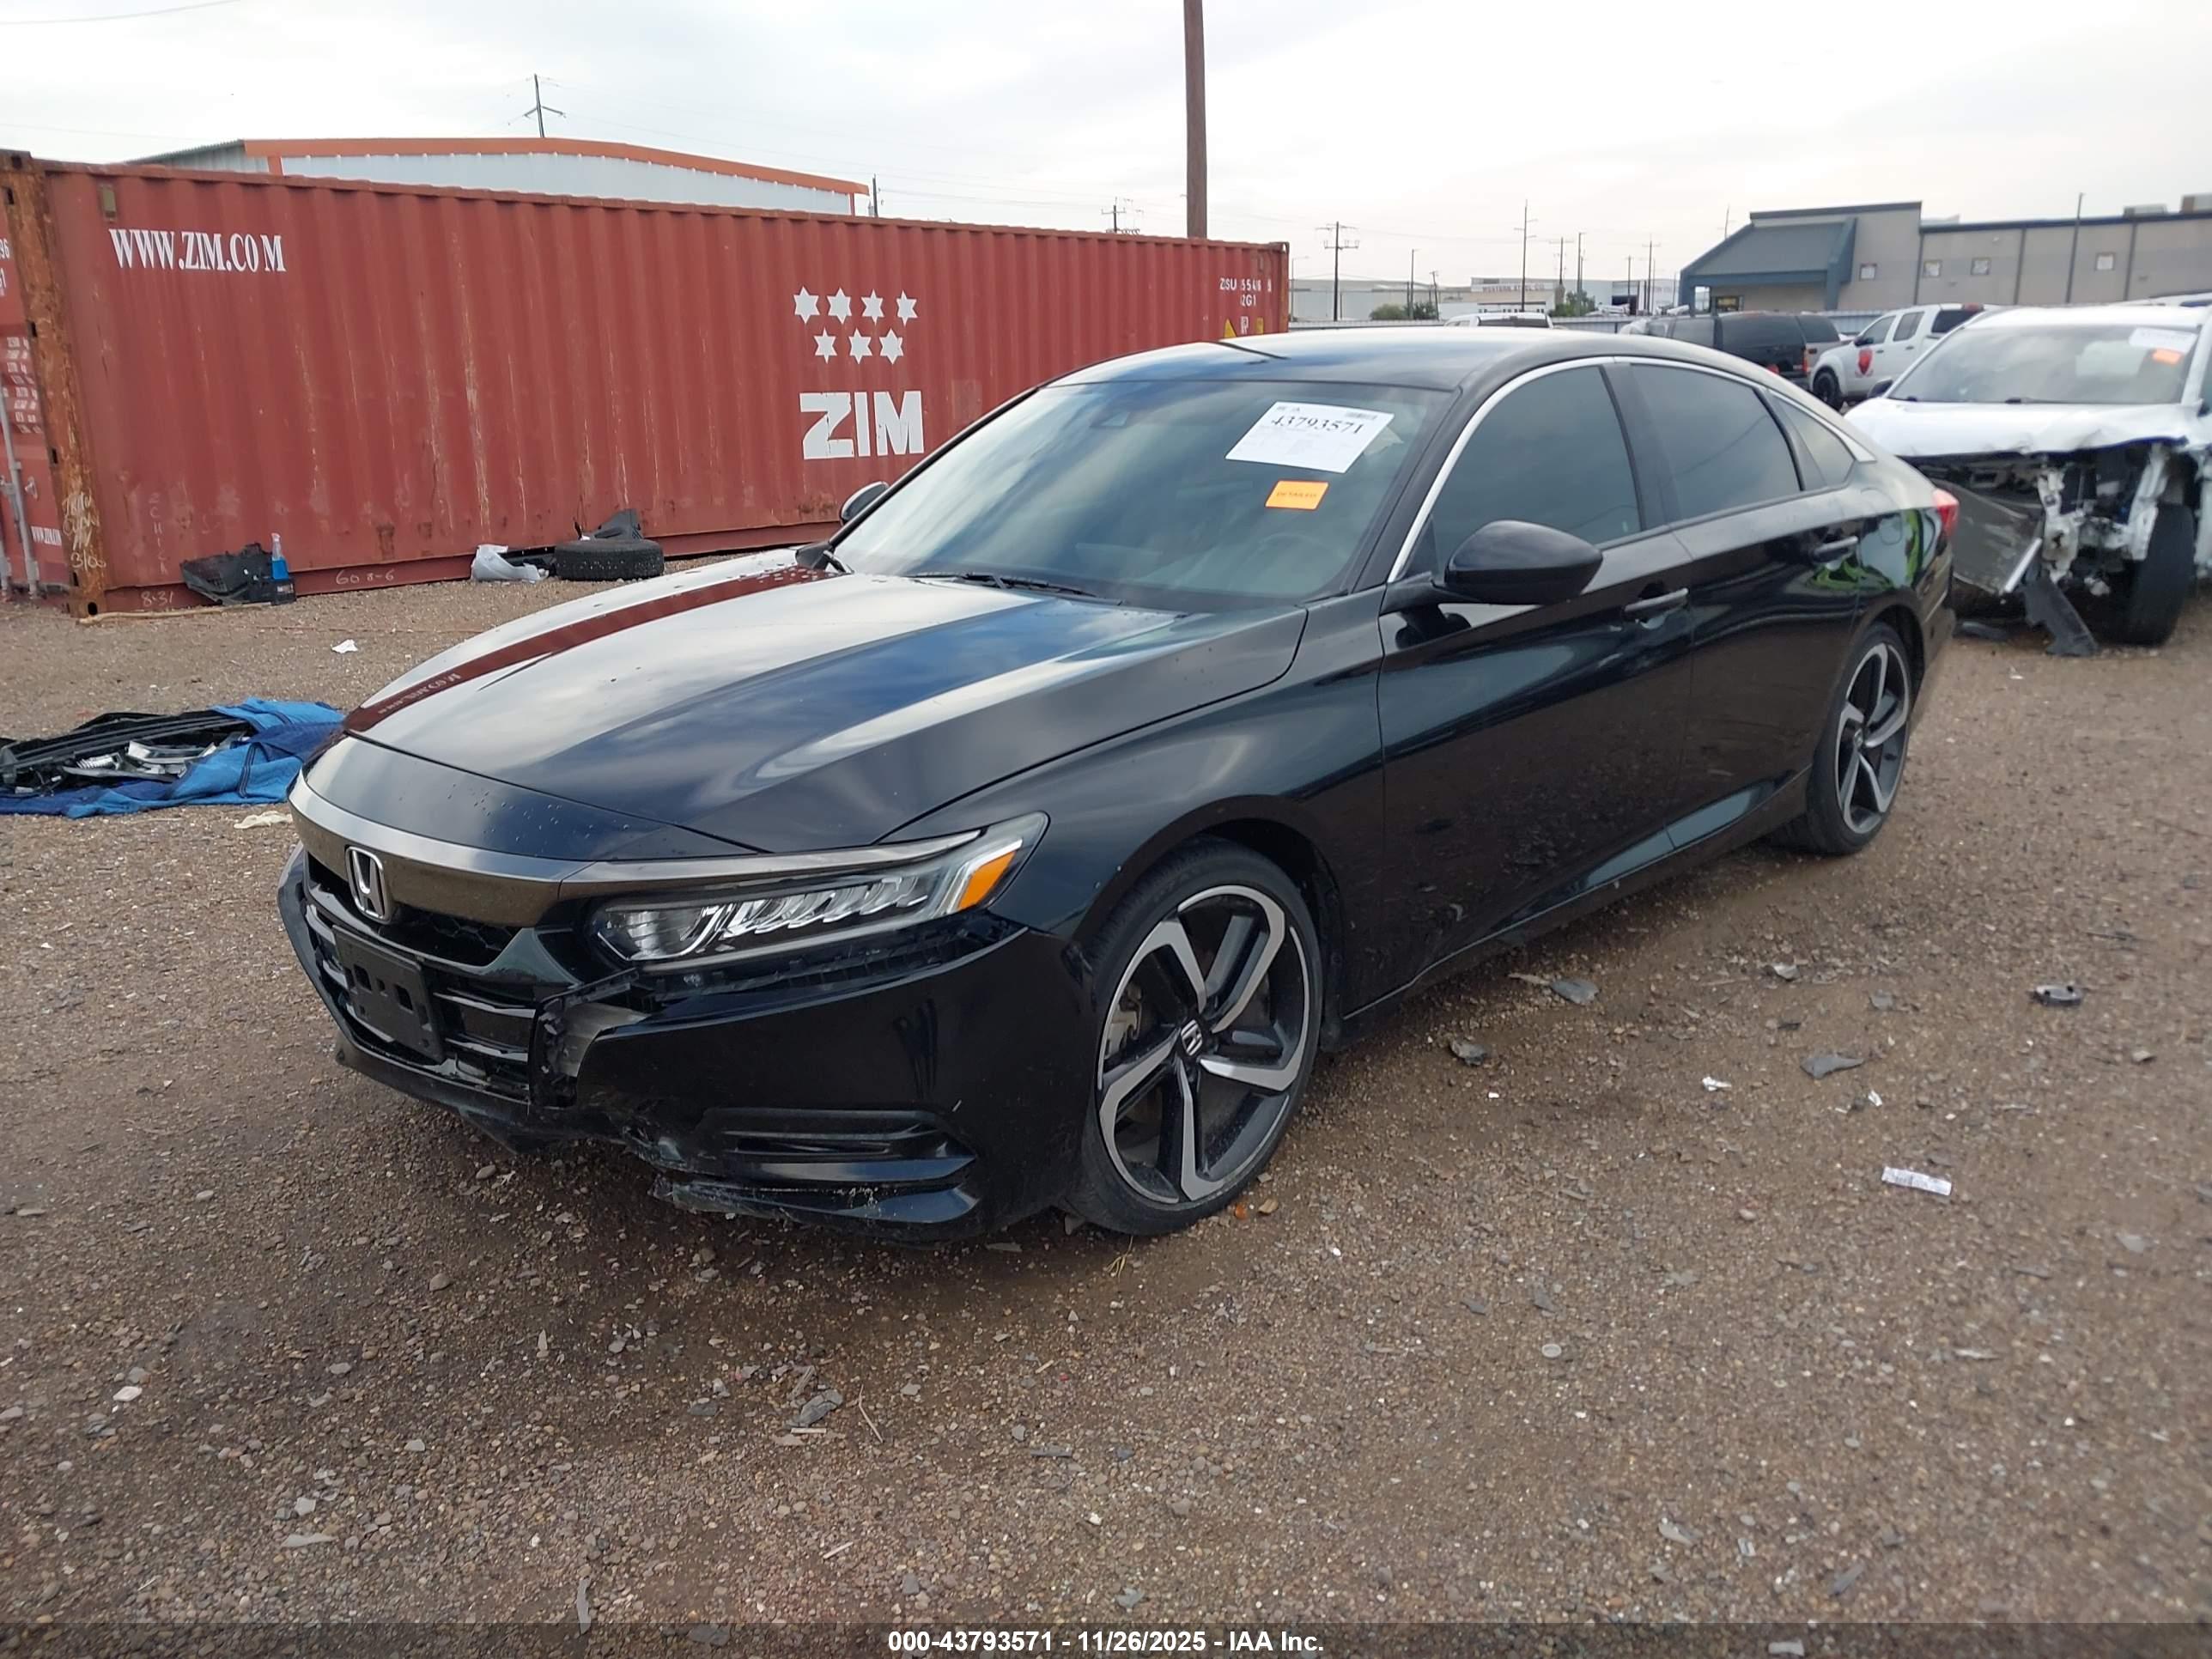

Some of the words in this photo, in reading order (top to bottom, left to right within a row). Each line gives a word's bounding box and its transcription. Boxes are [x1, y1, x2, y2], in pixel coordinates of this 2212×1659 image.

[108, 228, 287, 272] WWW.ZIM.COM
[799, 390, 925, 459] ZIM
[1271, 414, 1365, 434] 43793571
